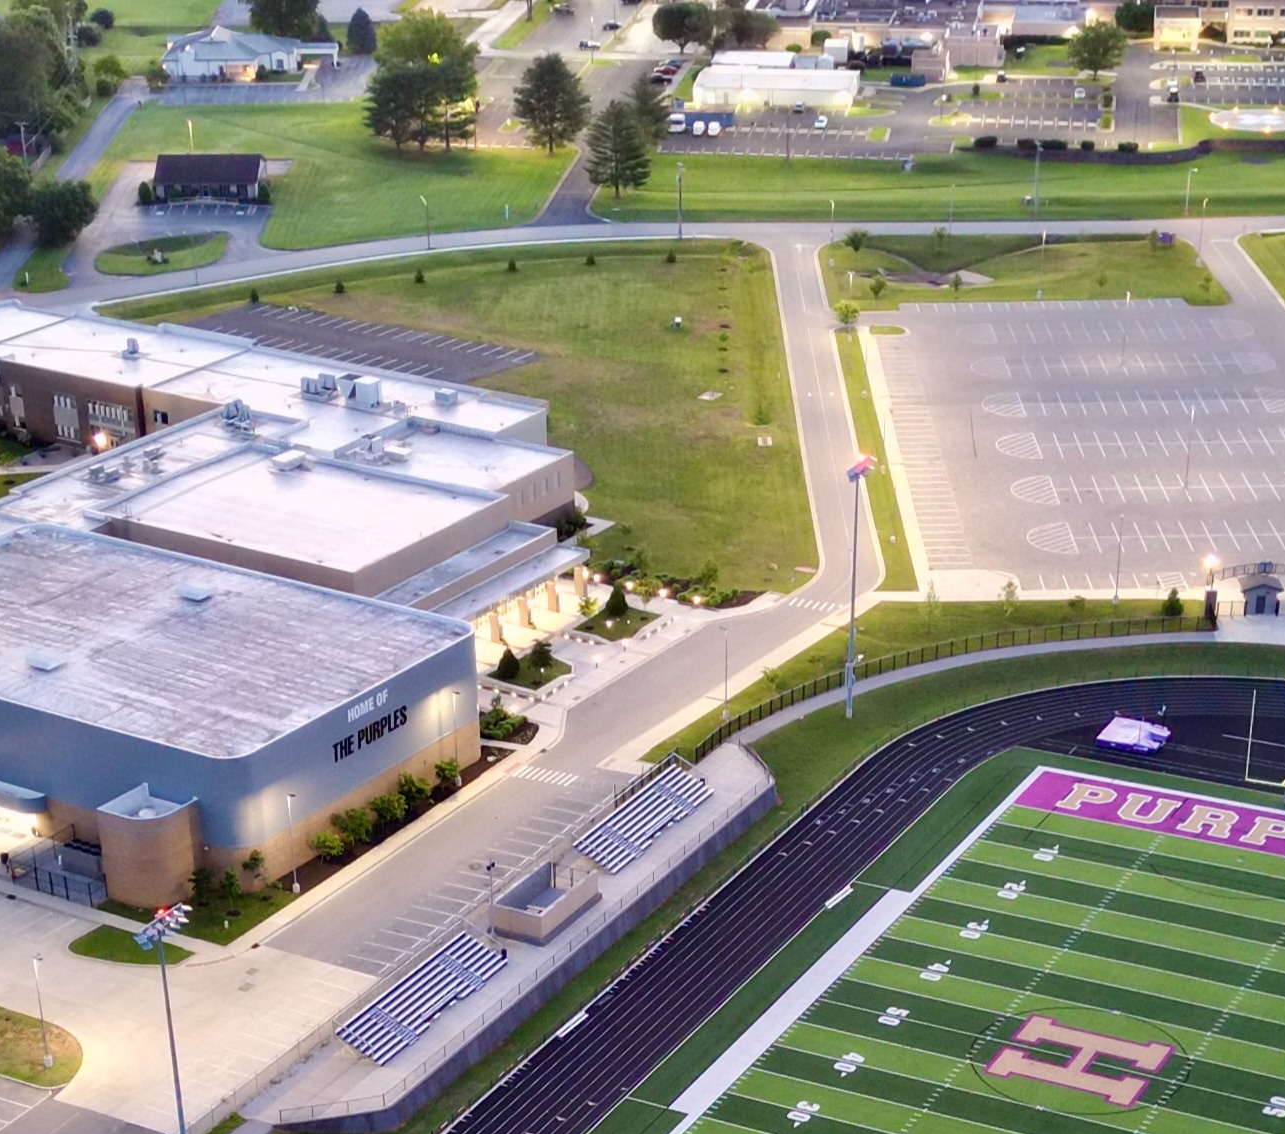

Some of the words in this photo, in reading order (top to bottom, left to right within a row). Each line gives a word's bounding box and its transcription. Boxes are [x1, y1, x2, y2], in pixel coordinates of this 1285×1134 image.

[347, 696, 375, 723] HOME
[376, 689, 389, 707] OF
[332, 734, 354, 763] THE
[357, 705, 408, 749] PURPLES
[878, 1007, 910, 1026] 50
[834, 1052, 865, 1073] 40
[984, 1013, 1177, 1109] H
[787, 1100, 820, 1122] 30
